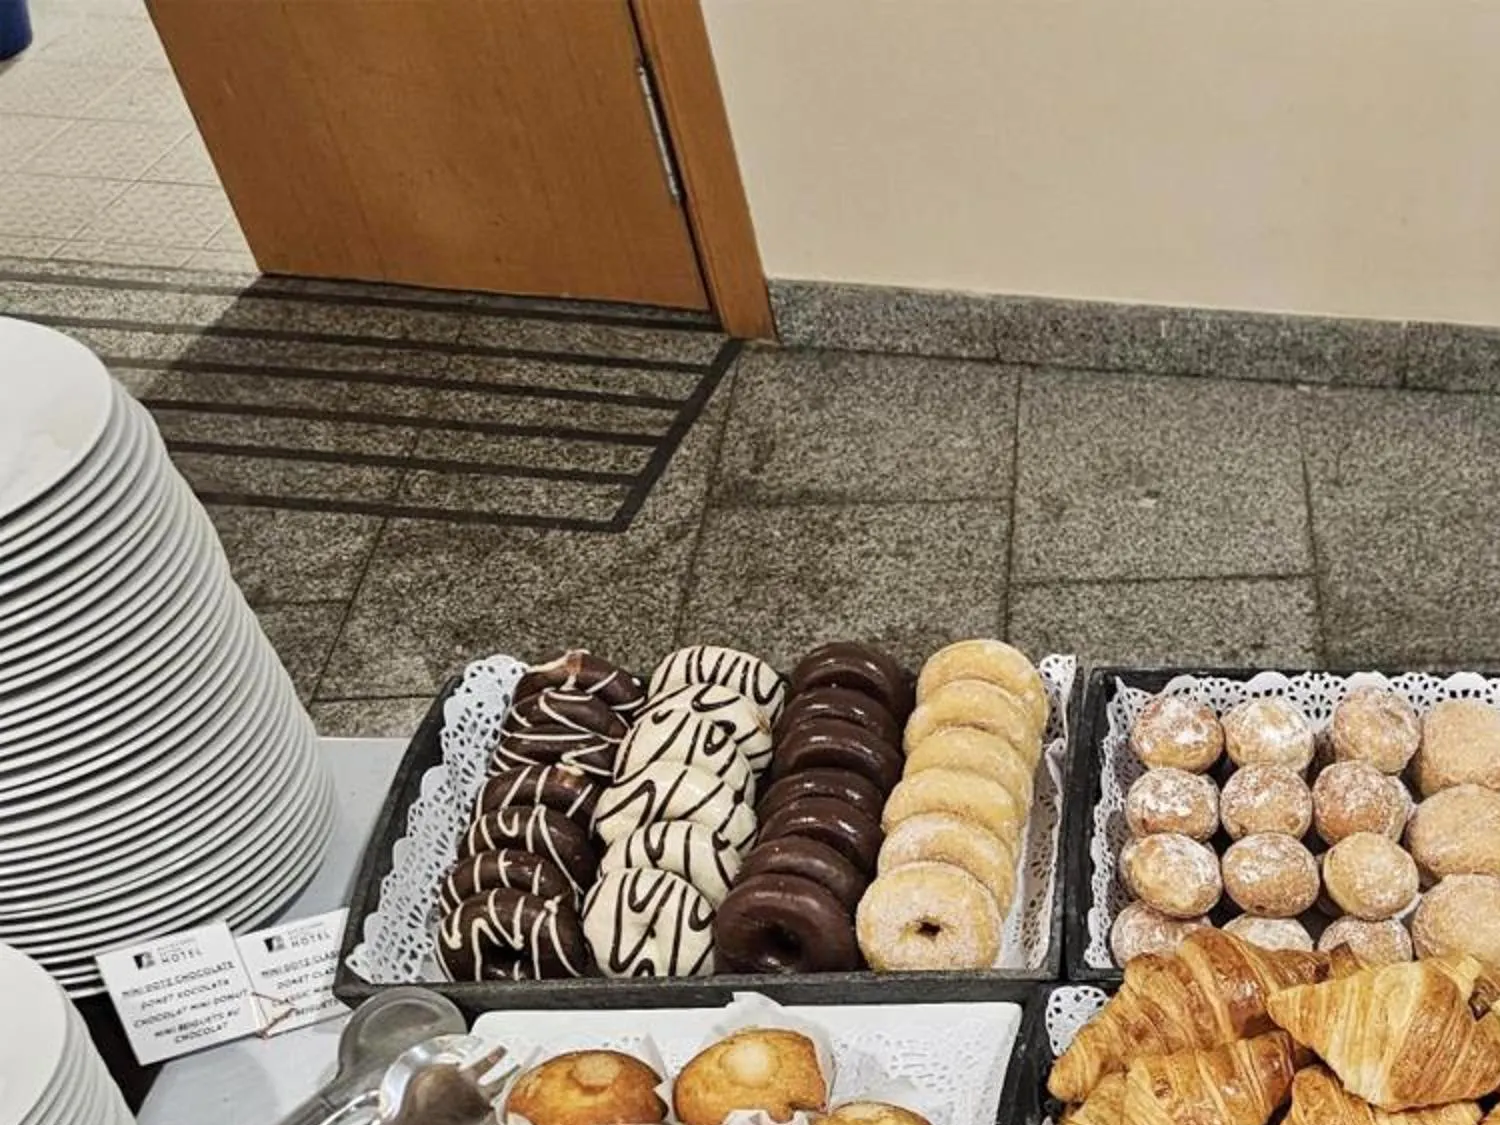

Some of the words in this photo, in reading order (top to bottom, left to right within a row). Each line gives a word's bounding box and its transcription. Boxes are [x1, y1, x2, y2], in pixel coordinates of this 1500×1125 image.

[290, 931, 331, 949] HOTEL
[160, 947, 203, 963] HOTEL
[175, 960, 236, 984] CHOCOLATE
